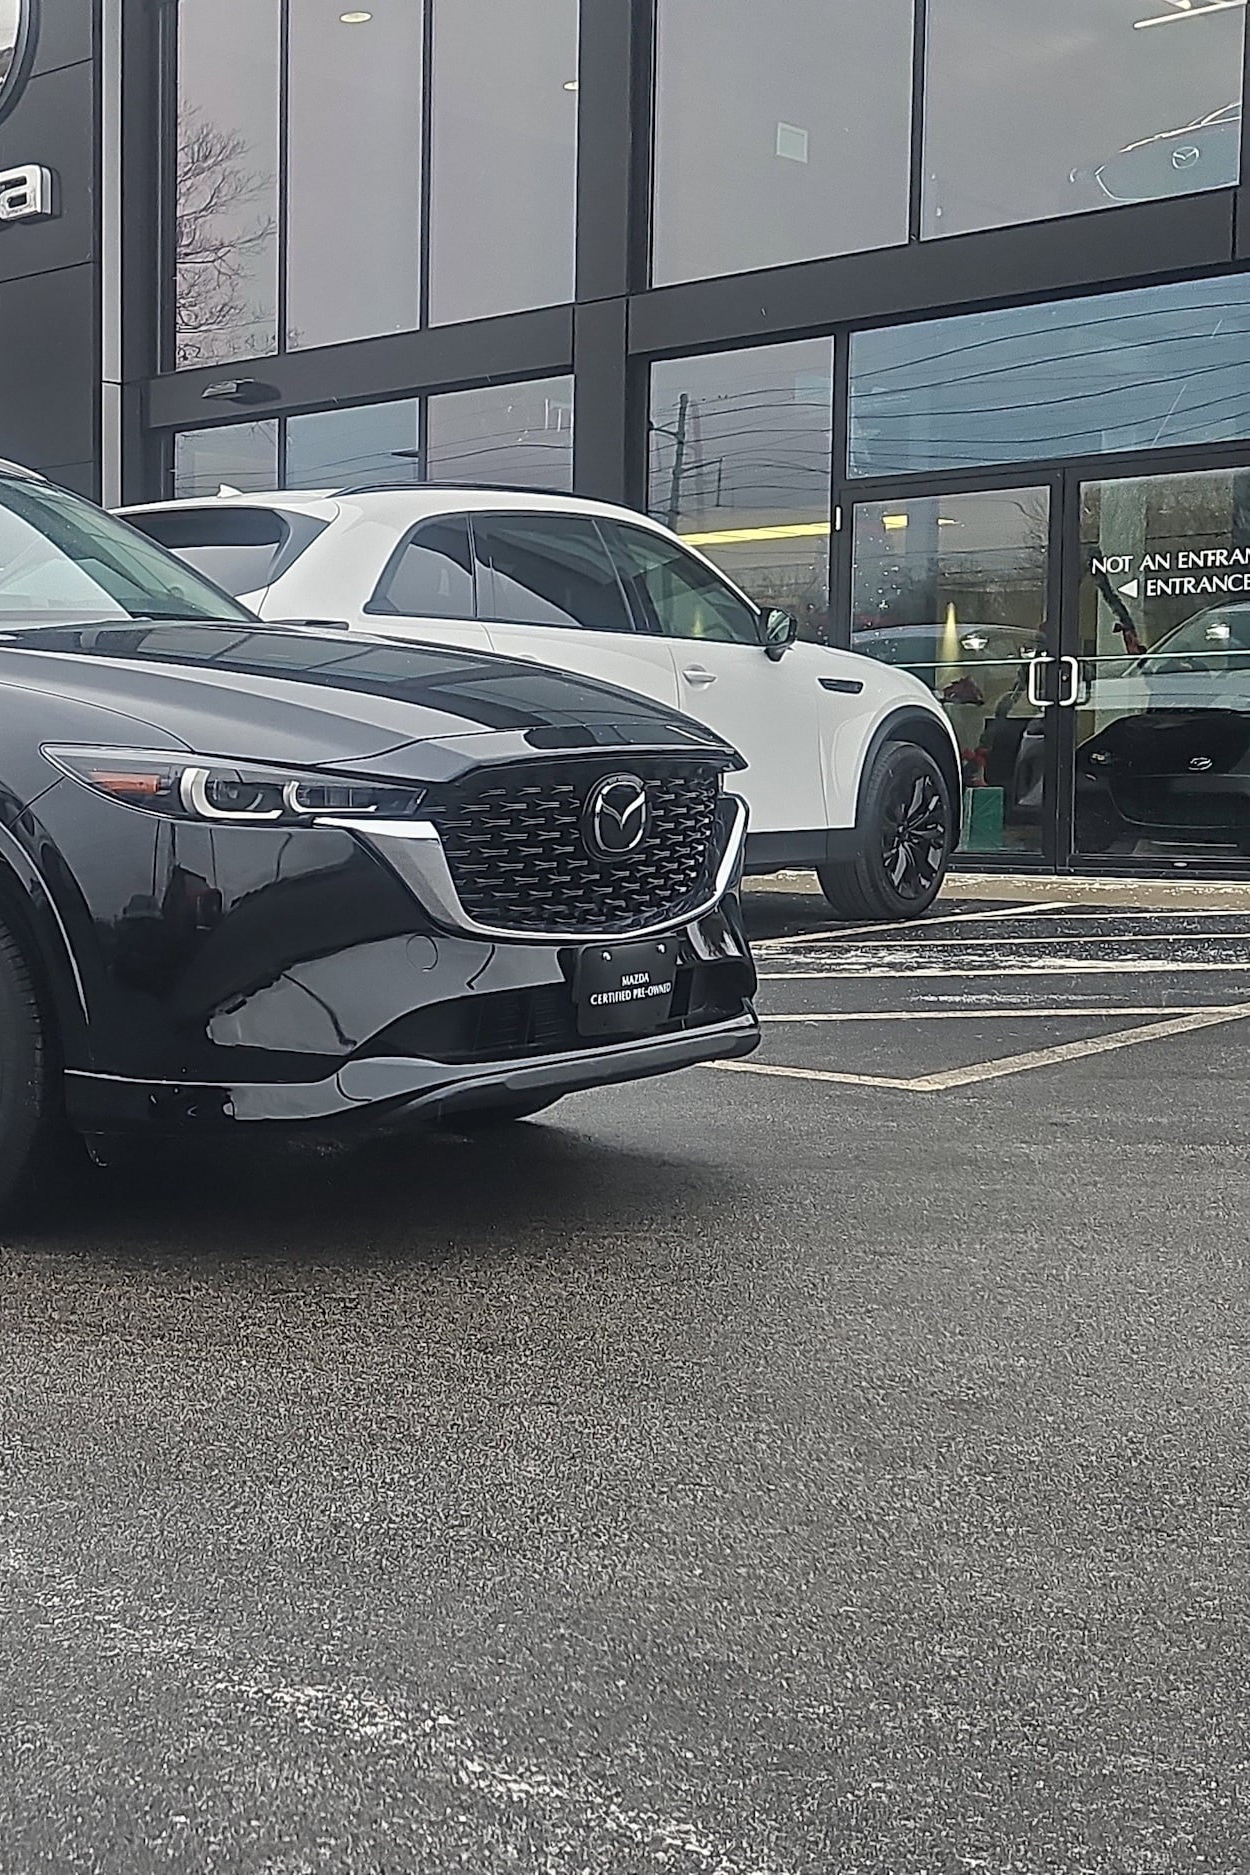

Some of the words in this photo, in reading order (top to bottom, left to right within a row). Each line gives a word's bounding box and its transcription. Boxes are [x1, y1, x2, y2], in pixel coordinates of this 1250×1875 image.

[1091, 555, 1133, 574] NOT
[1139, 553, 1170, 571] AN
[1146, 573, 1250, 596] ENTRANCE
[622, 973, 650, 987] MAZDA
[590, 990, 632, 1005] CERTIFIED
[633, 982, 672, 999] PRE-OWNED
